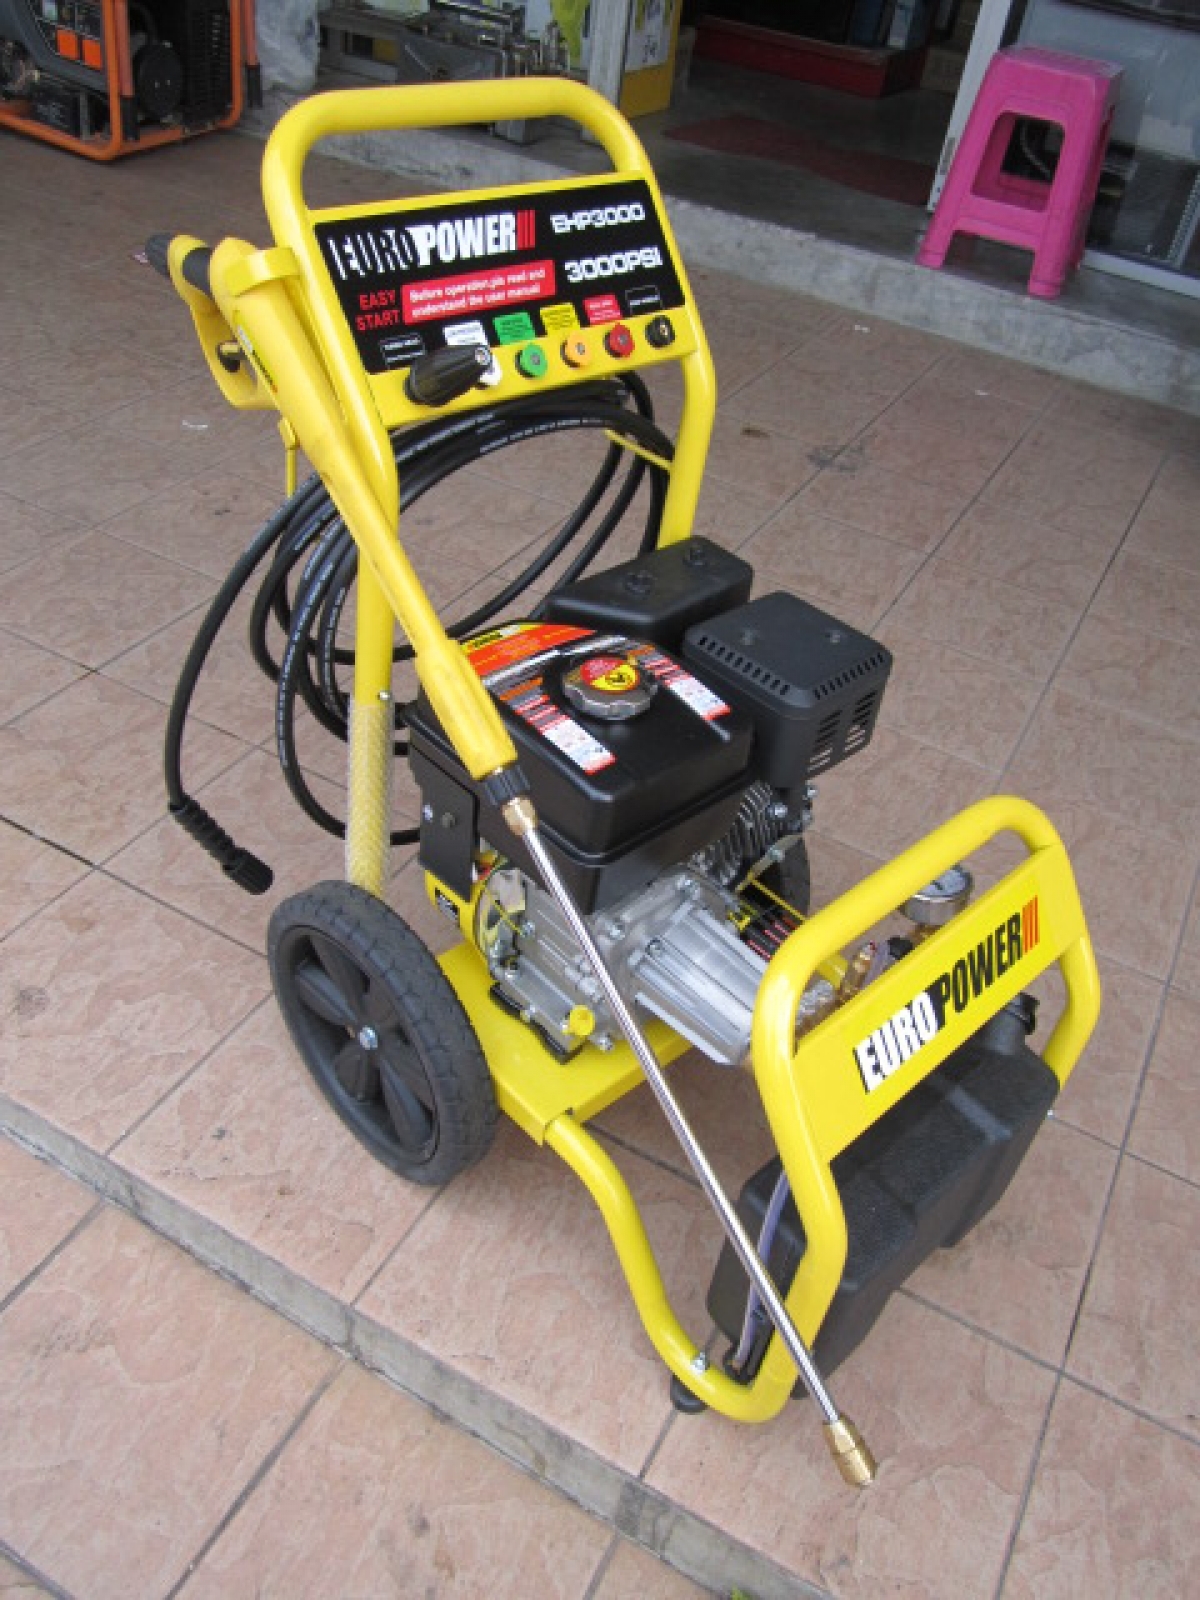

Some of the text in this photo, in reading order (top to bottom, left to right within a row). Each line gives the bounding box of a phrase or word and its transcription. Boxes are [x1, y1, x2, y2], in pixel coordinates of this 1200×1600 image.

[564, 246, 663, 282] 3000PSI
[359, 290, 395, 311] EASY
[356, 309, 399, 331] START
